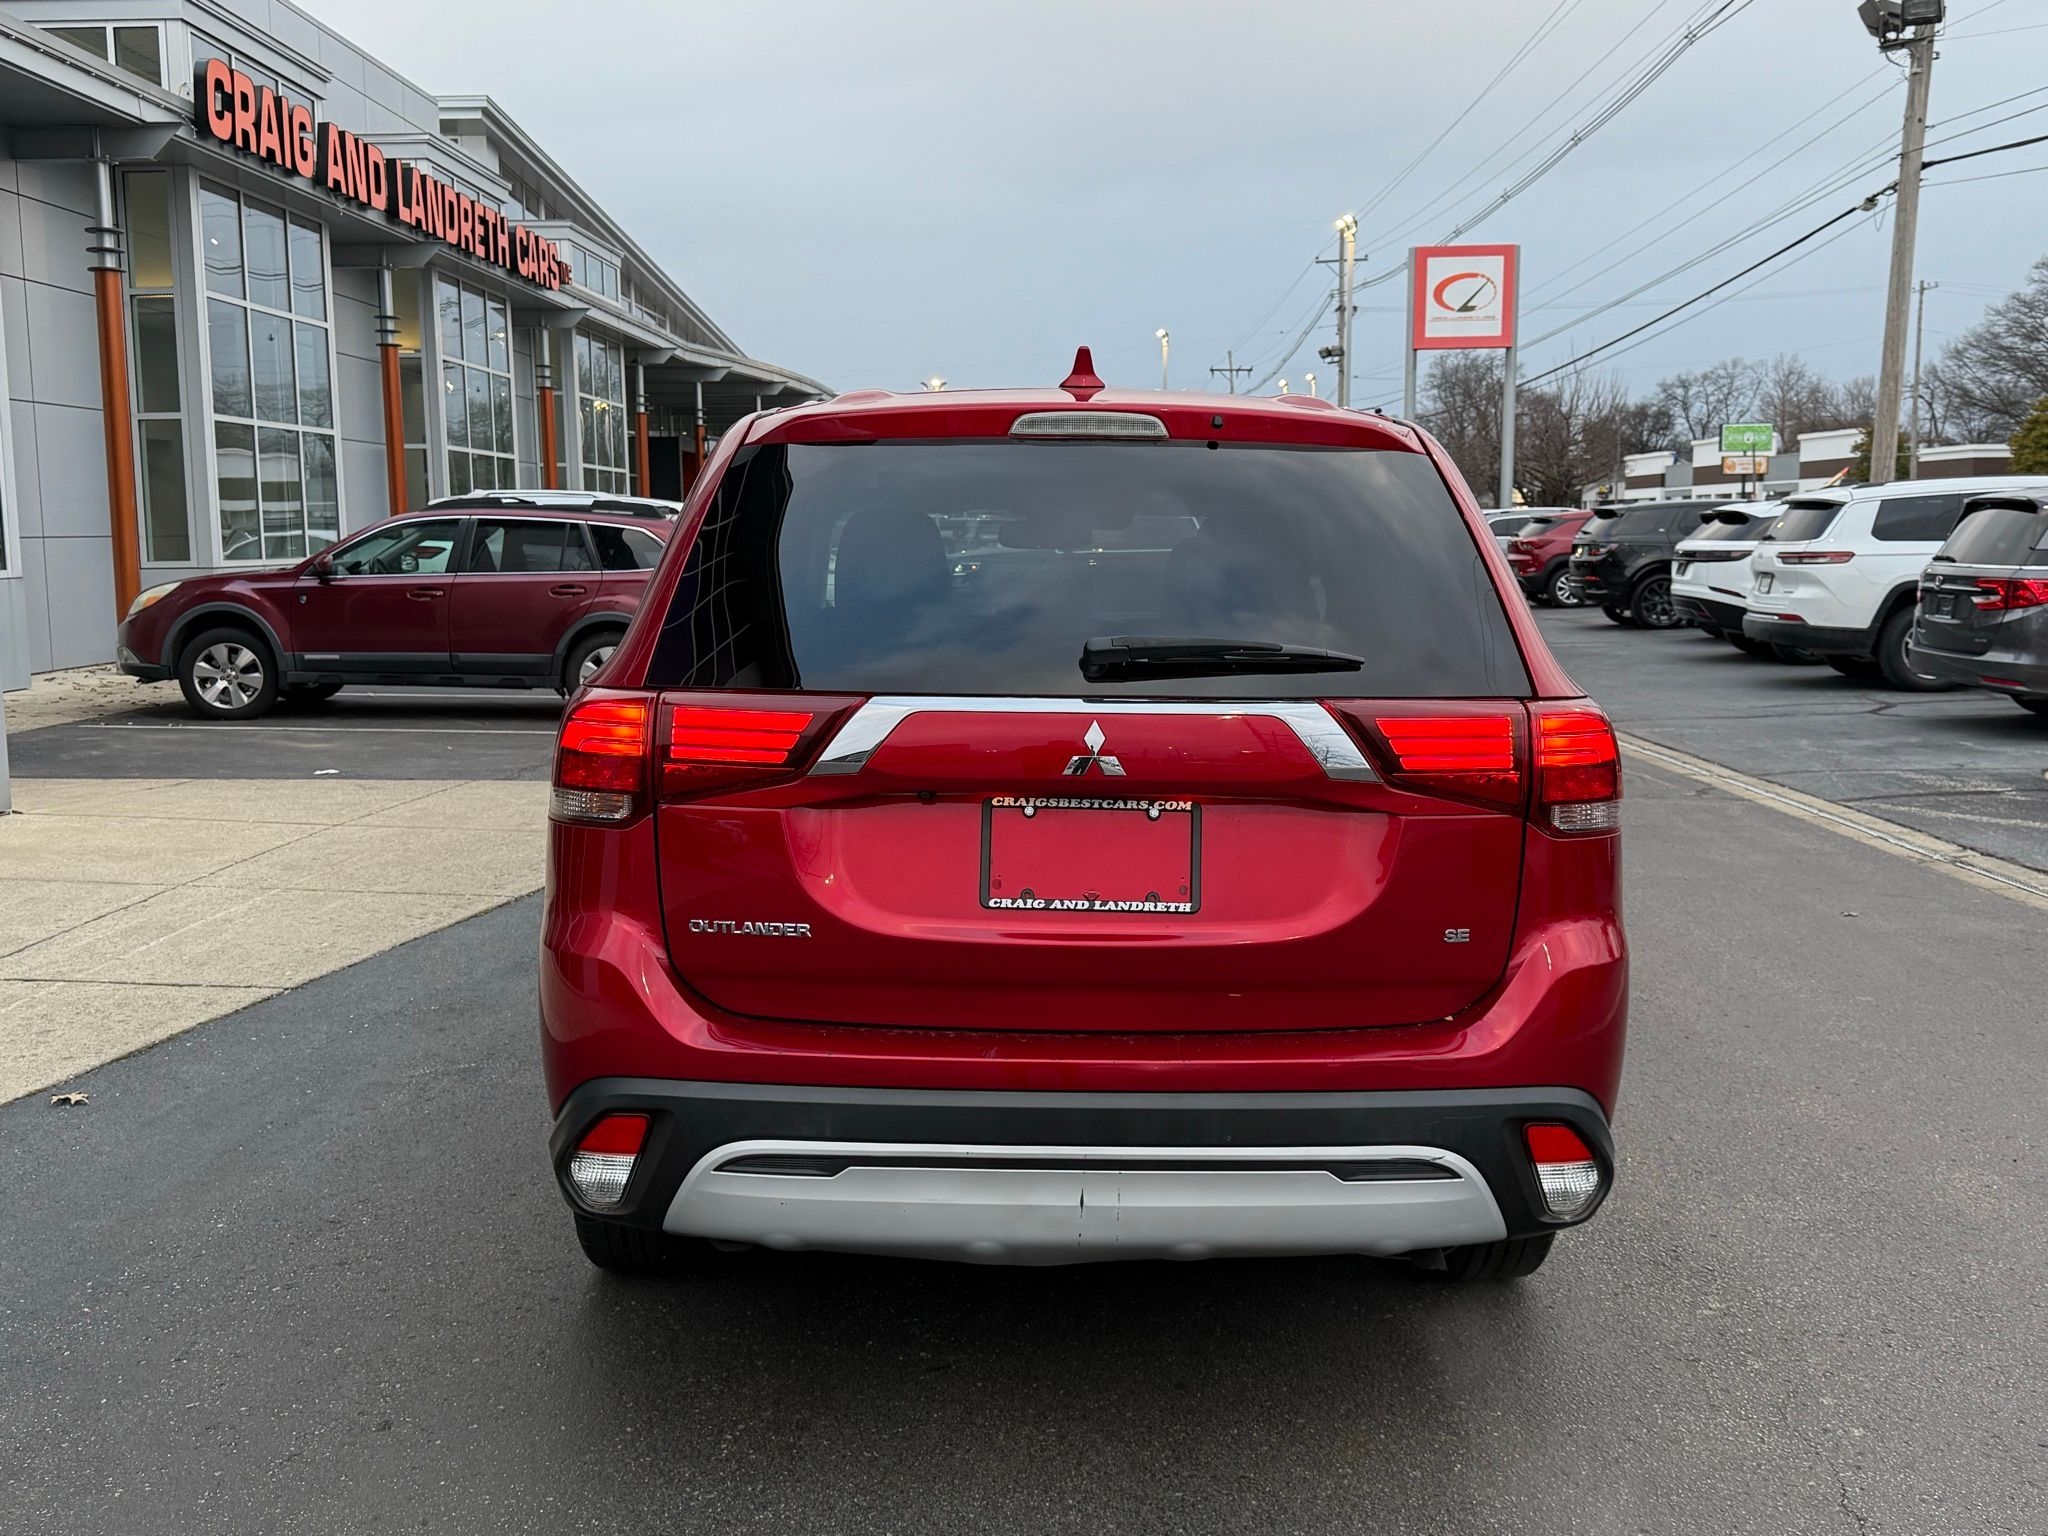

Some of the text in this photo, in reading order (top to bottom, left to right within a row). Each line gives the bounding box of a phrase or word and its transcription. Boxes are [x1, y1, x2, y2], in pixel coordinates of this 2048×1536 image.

[206, 57, 315, 178] CRAIG
[327, 121, 387, 212] AND
[396, 159, 510, 270] LANDRETH
[515, 224, 560, 291] CARS
[991, 797, 1193, 810] CRAIGSBESTCARS.COM
[988, 898, 1192, 912] CRAIG AND LANDRETH
[688, 919, 812, 938] OUTLANDER
[1443, 928, 1470, 943] SE
